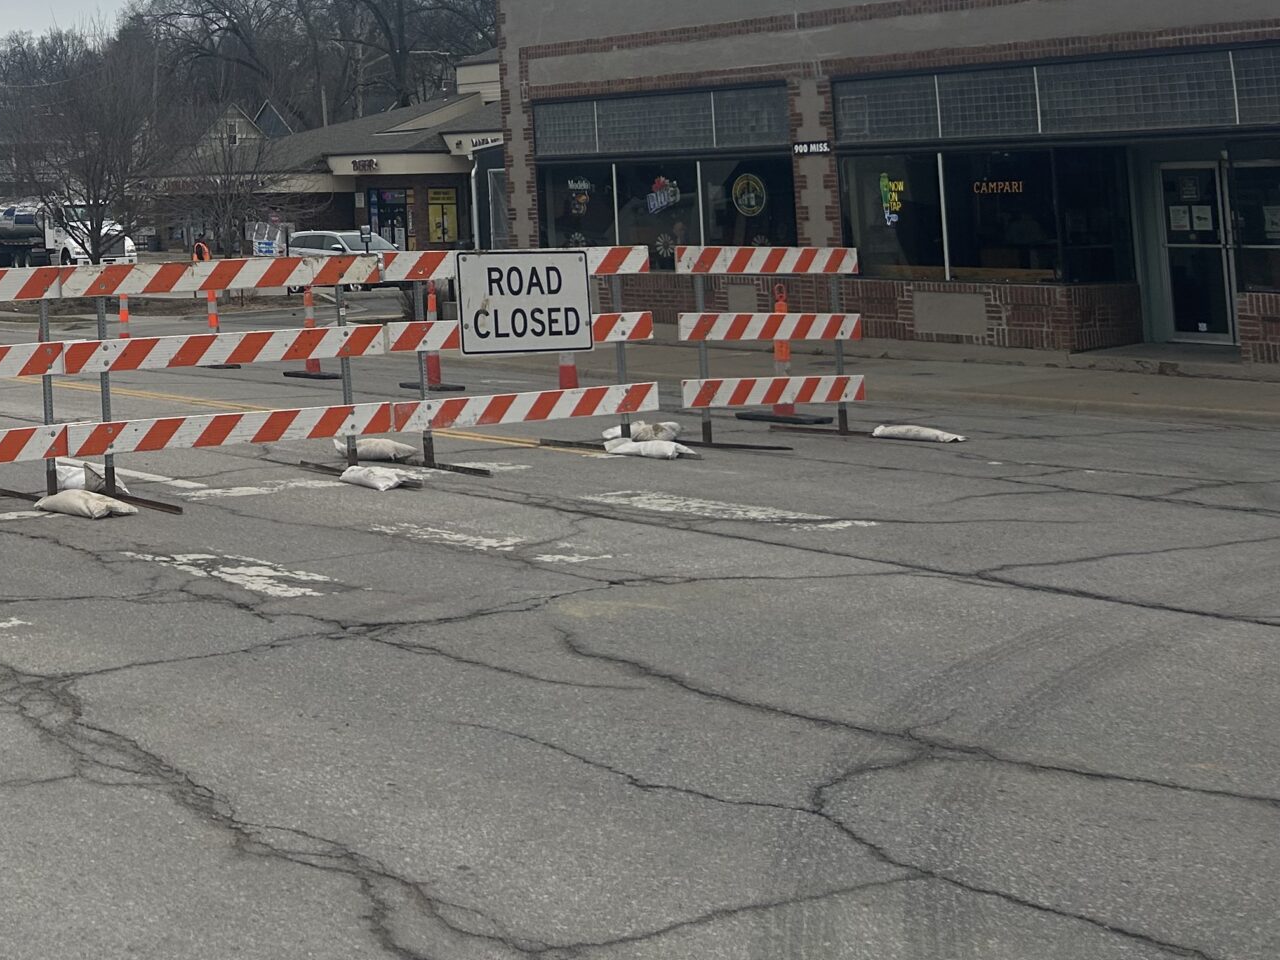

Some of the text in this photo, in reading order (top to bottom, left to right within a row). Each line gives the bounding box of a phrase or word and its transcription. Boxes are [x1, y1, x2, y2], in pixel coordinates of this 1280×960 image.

[794, 143, 830, 153] 900 MISS.
[888, 181, 904, 191] NOW
[973, 181, 1023, 193] CAMPARI
[888, 192, 898, 201] ON
[889, 201, 902, 211] TAP
[487, 266, 562, 296] ROAD
[474, 307, 580, 339] CLOSED
